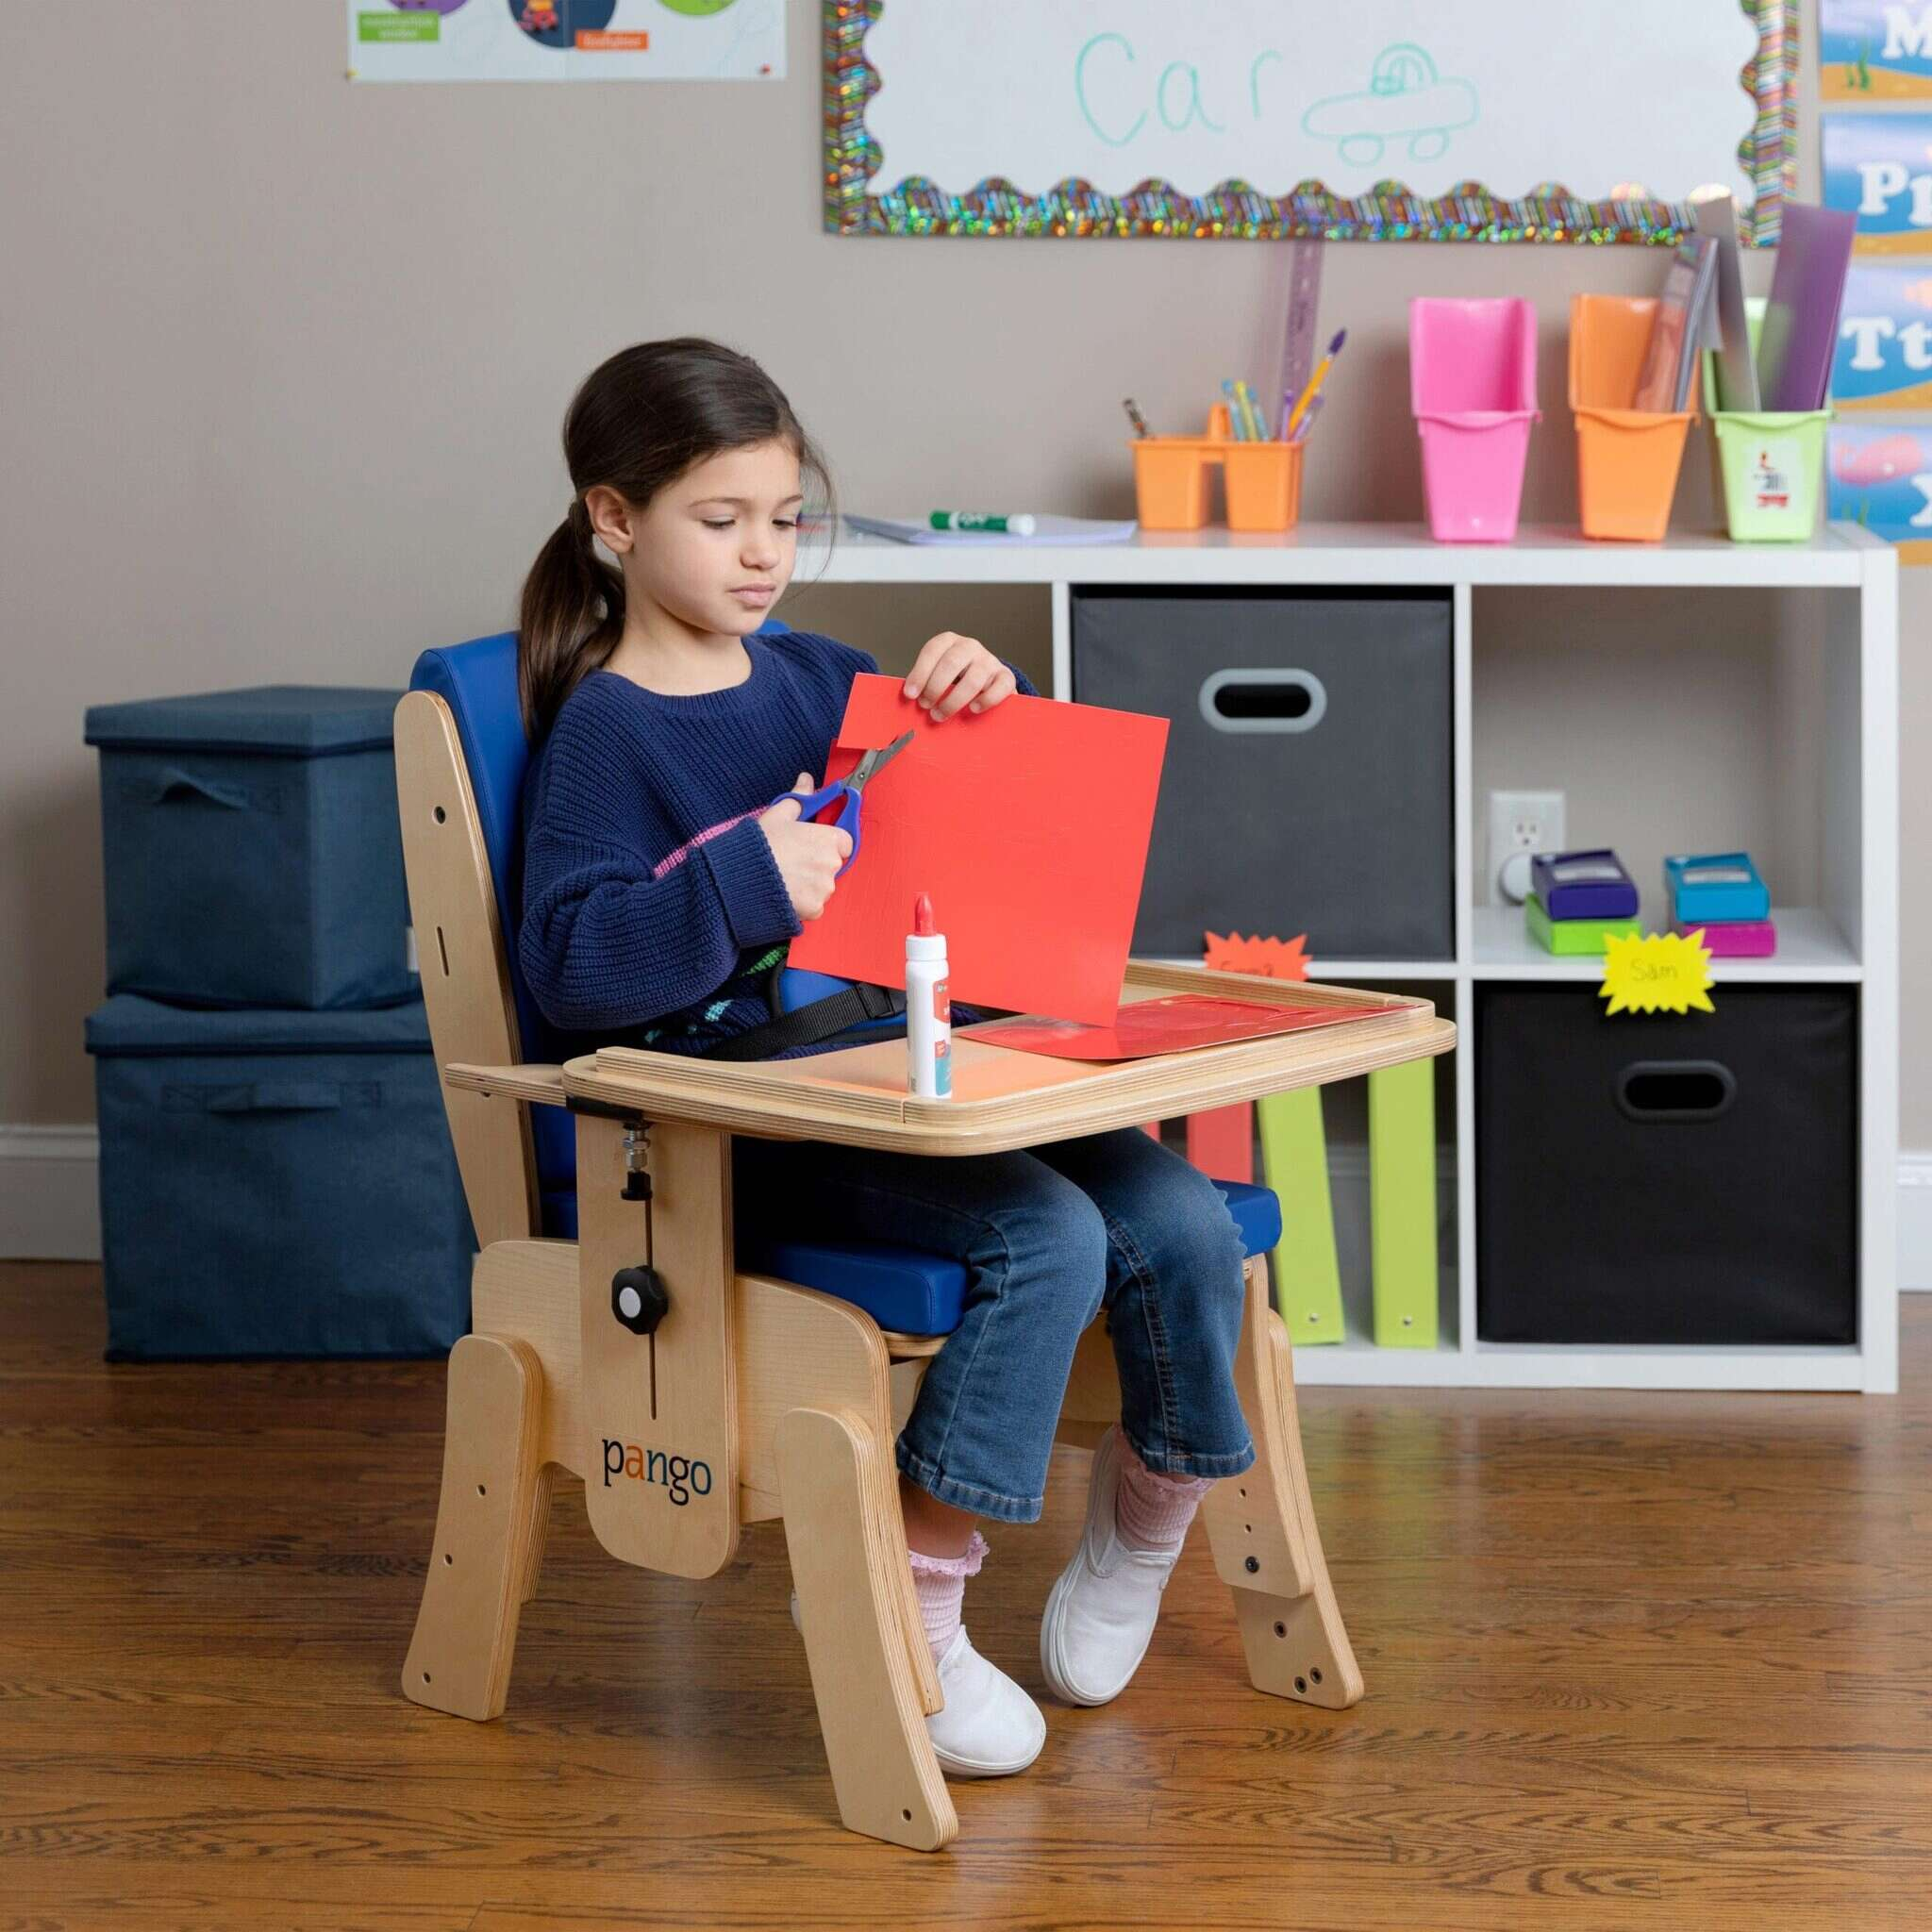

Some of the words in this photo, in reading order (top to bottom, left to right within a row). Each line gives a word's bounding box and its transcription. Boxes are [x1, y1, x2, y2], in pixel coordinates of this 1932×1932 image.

[1074, 32, 1282, 147] Car
[1842, 317, 1932, 370] Tt
[1630, 958, 1678, 982] Sam
[602, 1439, 711, 1506] pango
